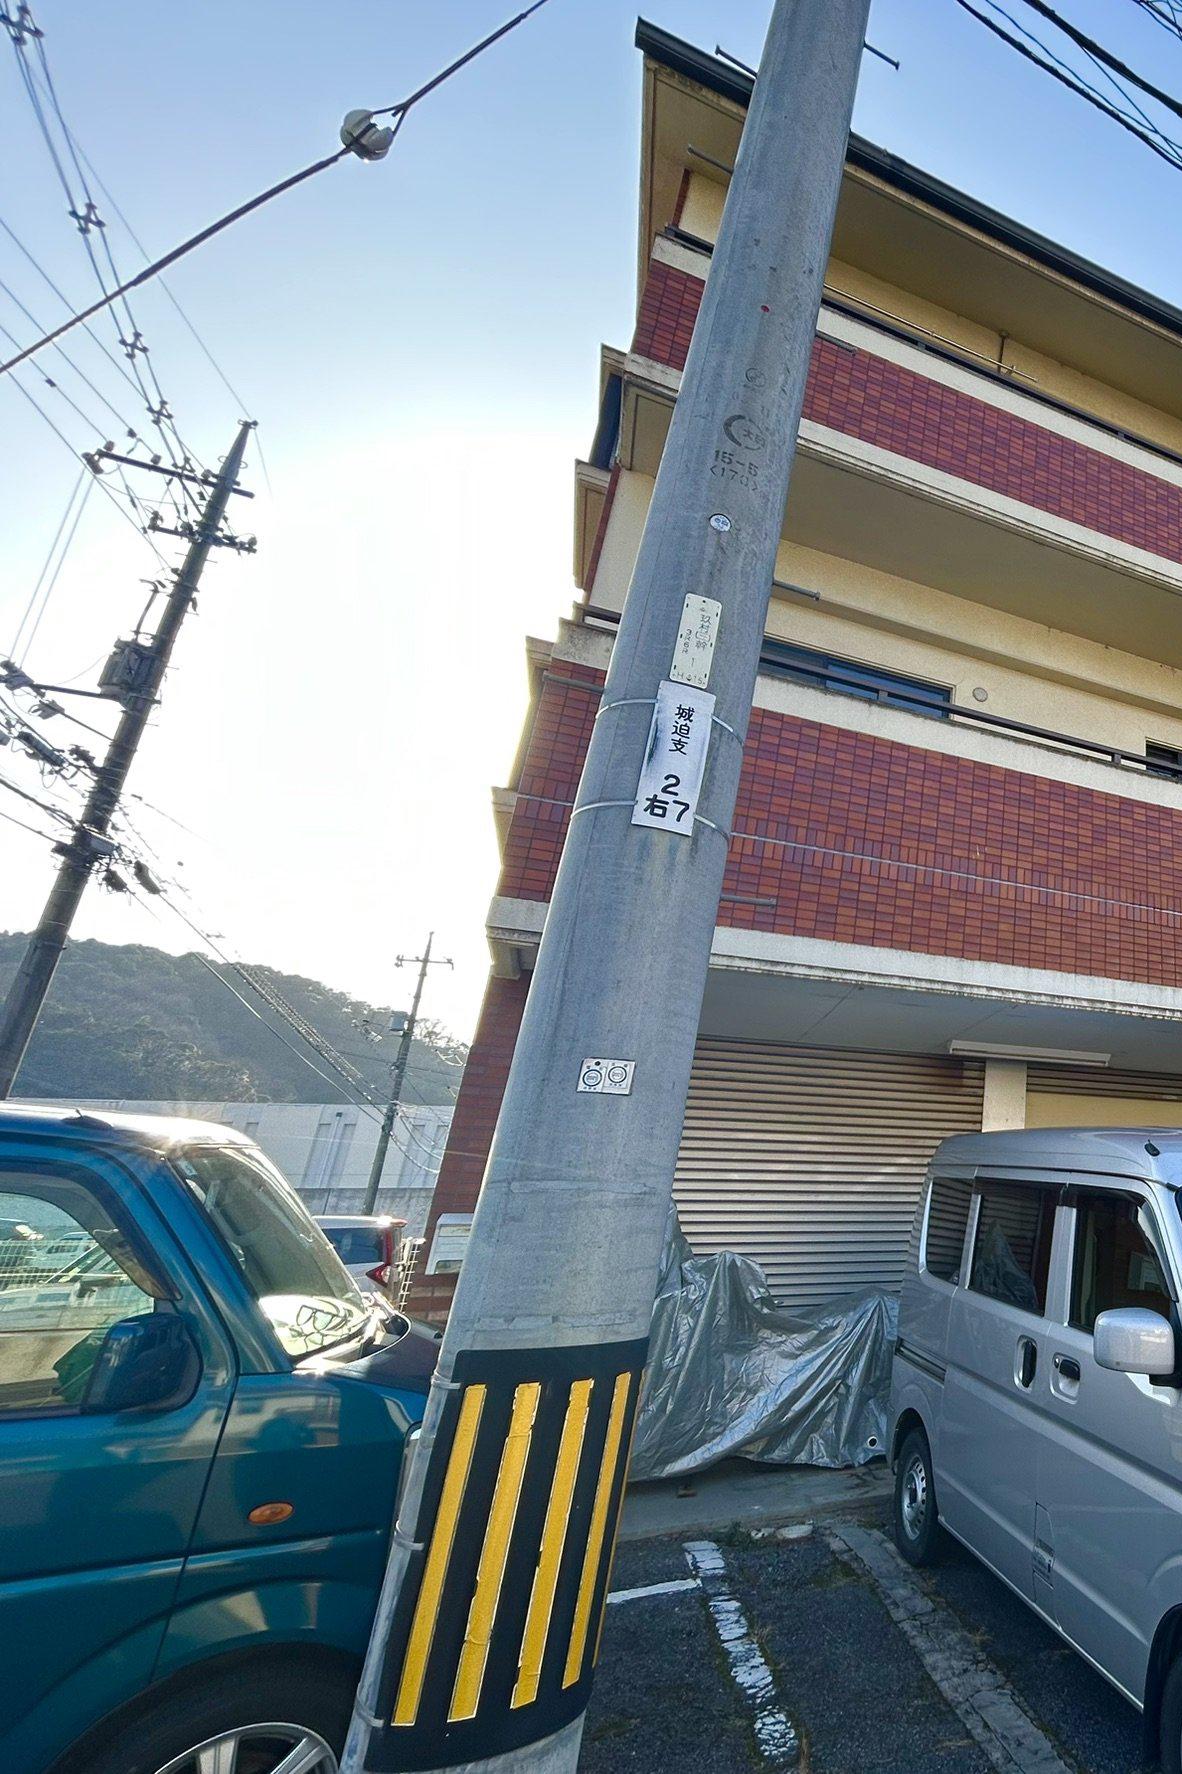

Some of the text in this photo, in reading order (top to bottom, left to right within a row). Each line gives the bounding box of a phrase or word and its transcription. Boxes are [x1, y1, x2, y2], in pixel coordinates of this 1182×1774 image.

[669, 704, 695, 756] 城迫支
[661, 773, 681, 797] 2
